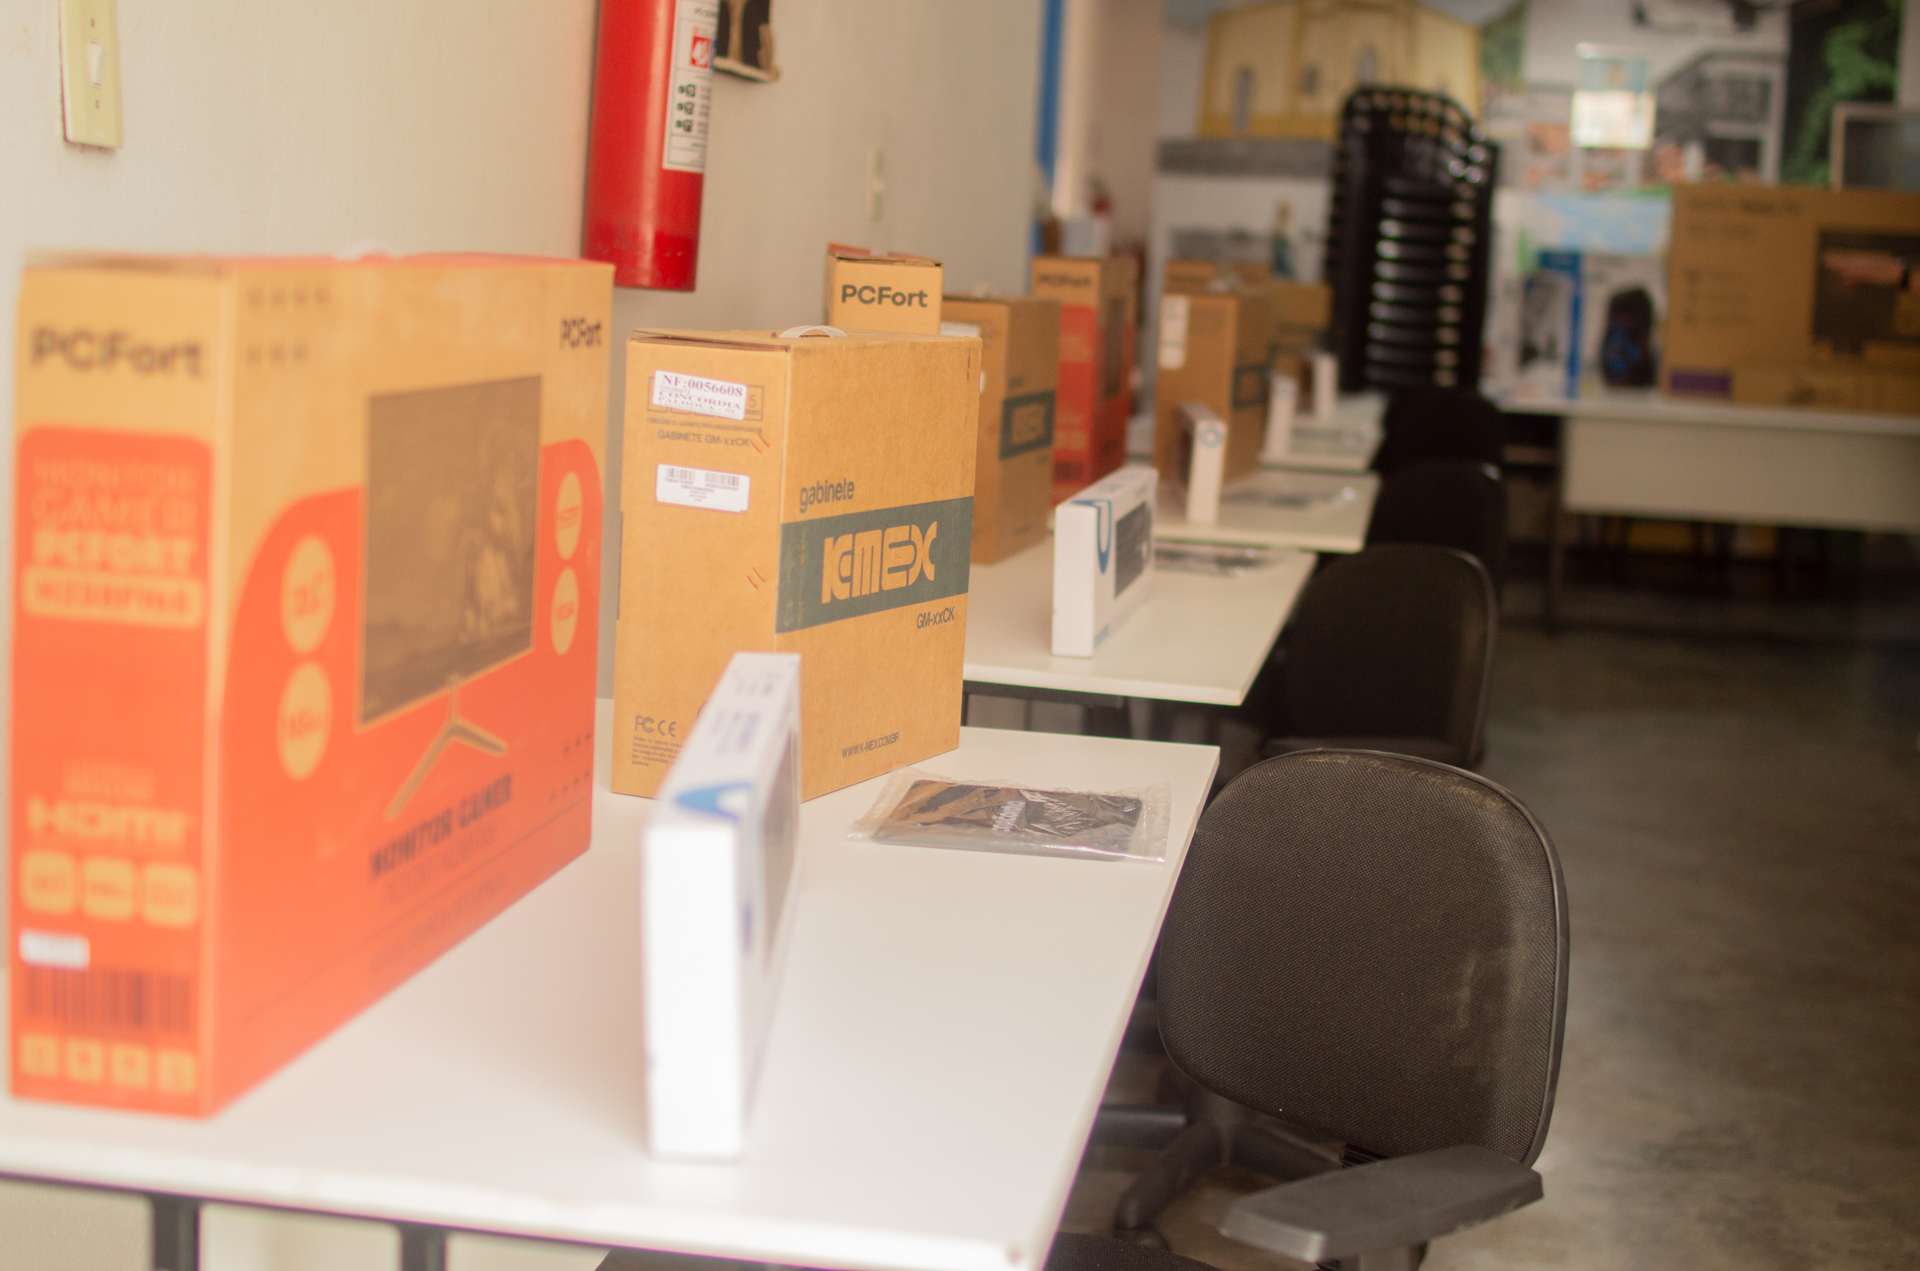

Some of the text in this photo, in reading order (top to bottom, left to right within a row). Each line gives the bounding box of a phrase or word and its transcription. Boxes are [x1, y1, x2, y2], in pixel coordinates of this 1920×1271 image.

[841, 284, 928, 308] PCFort
[559, 317, 602, 350] PCFort
[31, 325, 206, 378] PCFort
[662, 374, 744, 398] NF:0056608
[659, 390, 741, 410] CONCORDIA
[657, 429, 702, 443] GABINETE
[799, 478, 855, 514] gabinete
[916, 606, 956, 630] GM-xxCK
